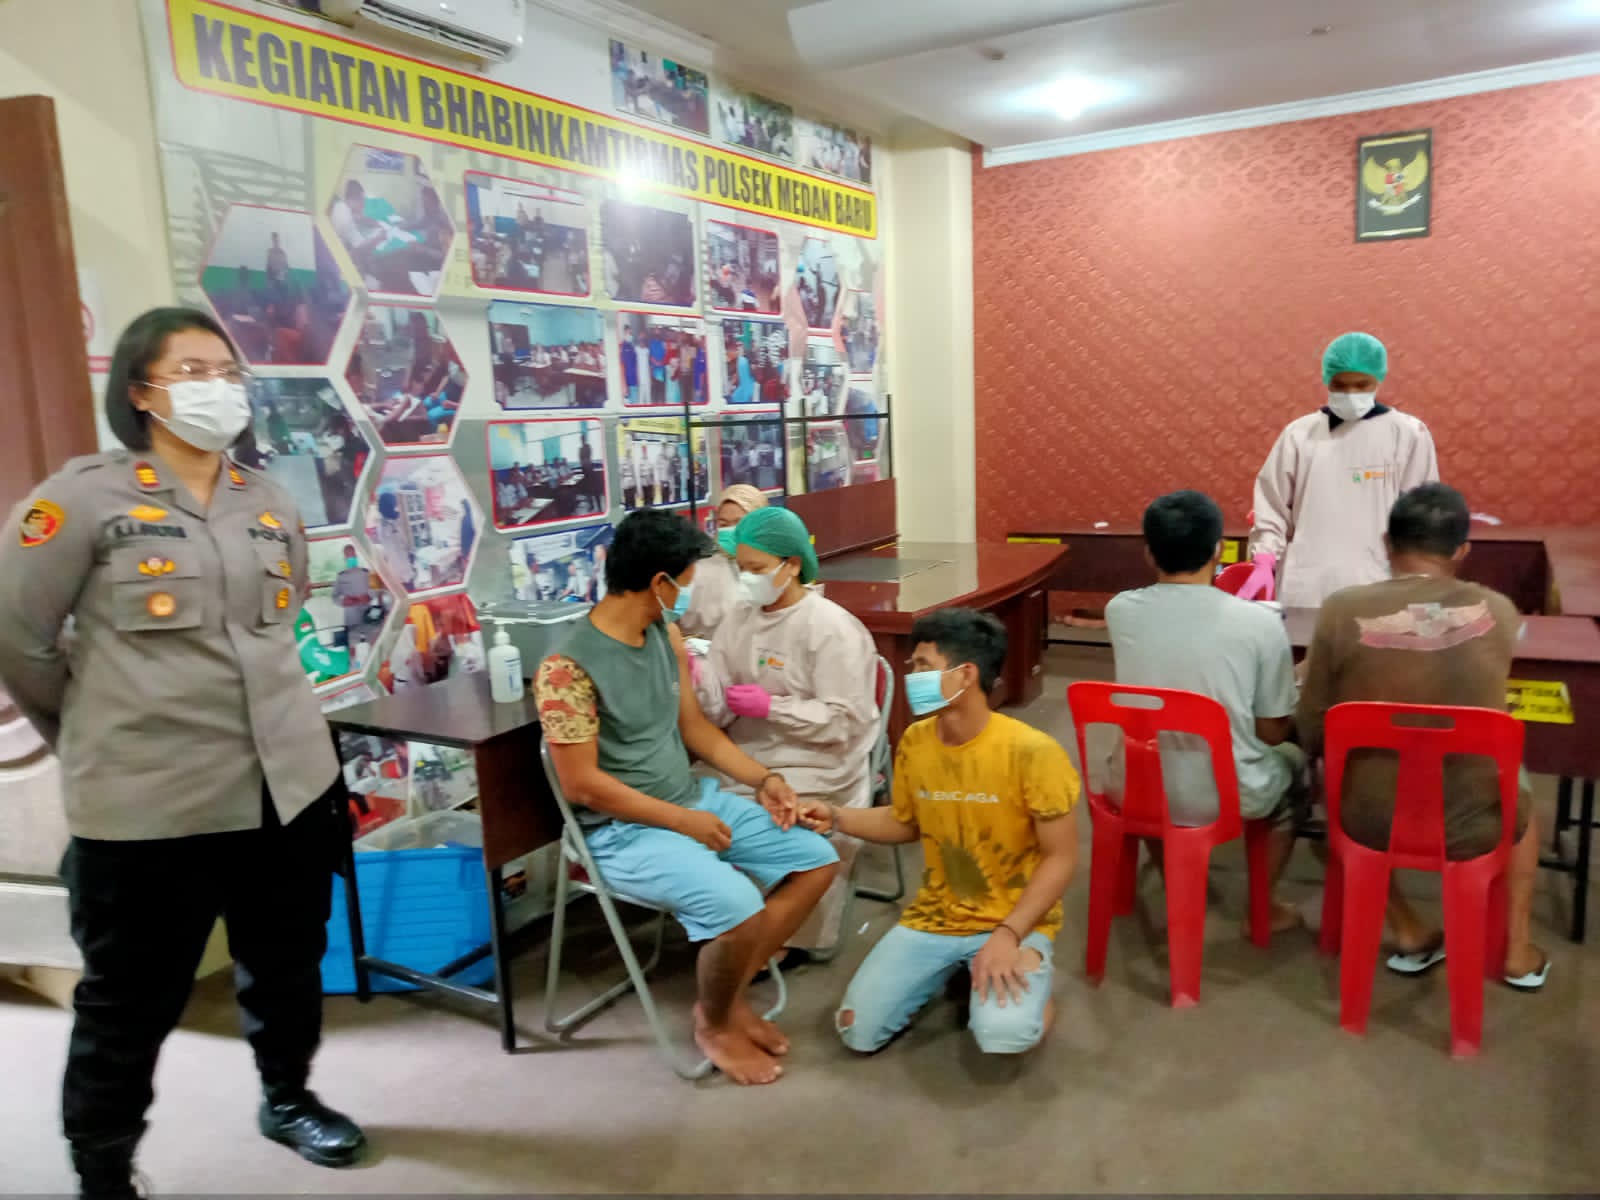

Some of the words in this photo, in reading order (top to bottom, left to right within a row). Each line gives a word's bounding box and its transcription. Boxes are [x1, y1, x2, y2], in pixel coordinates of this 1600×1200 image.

[191, 13, 410, 123] KEGIATAN
[704, 155, 774, 208] POLSEK
[778, 175, 831, 222] MEDAN
[834, 191, 872, 231] BARU
